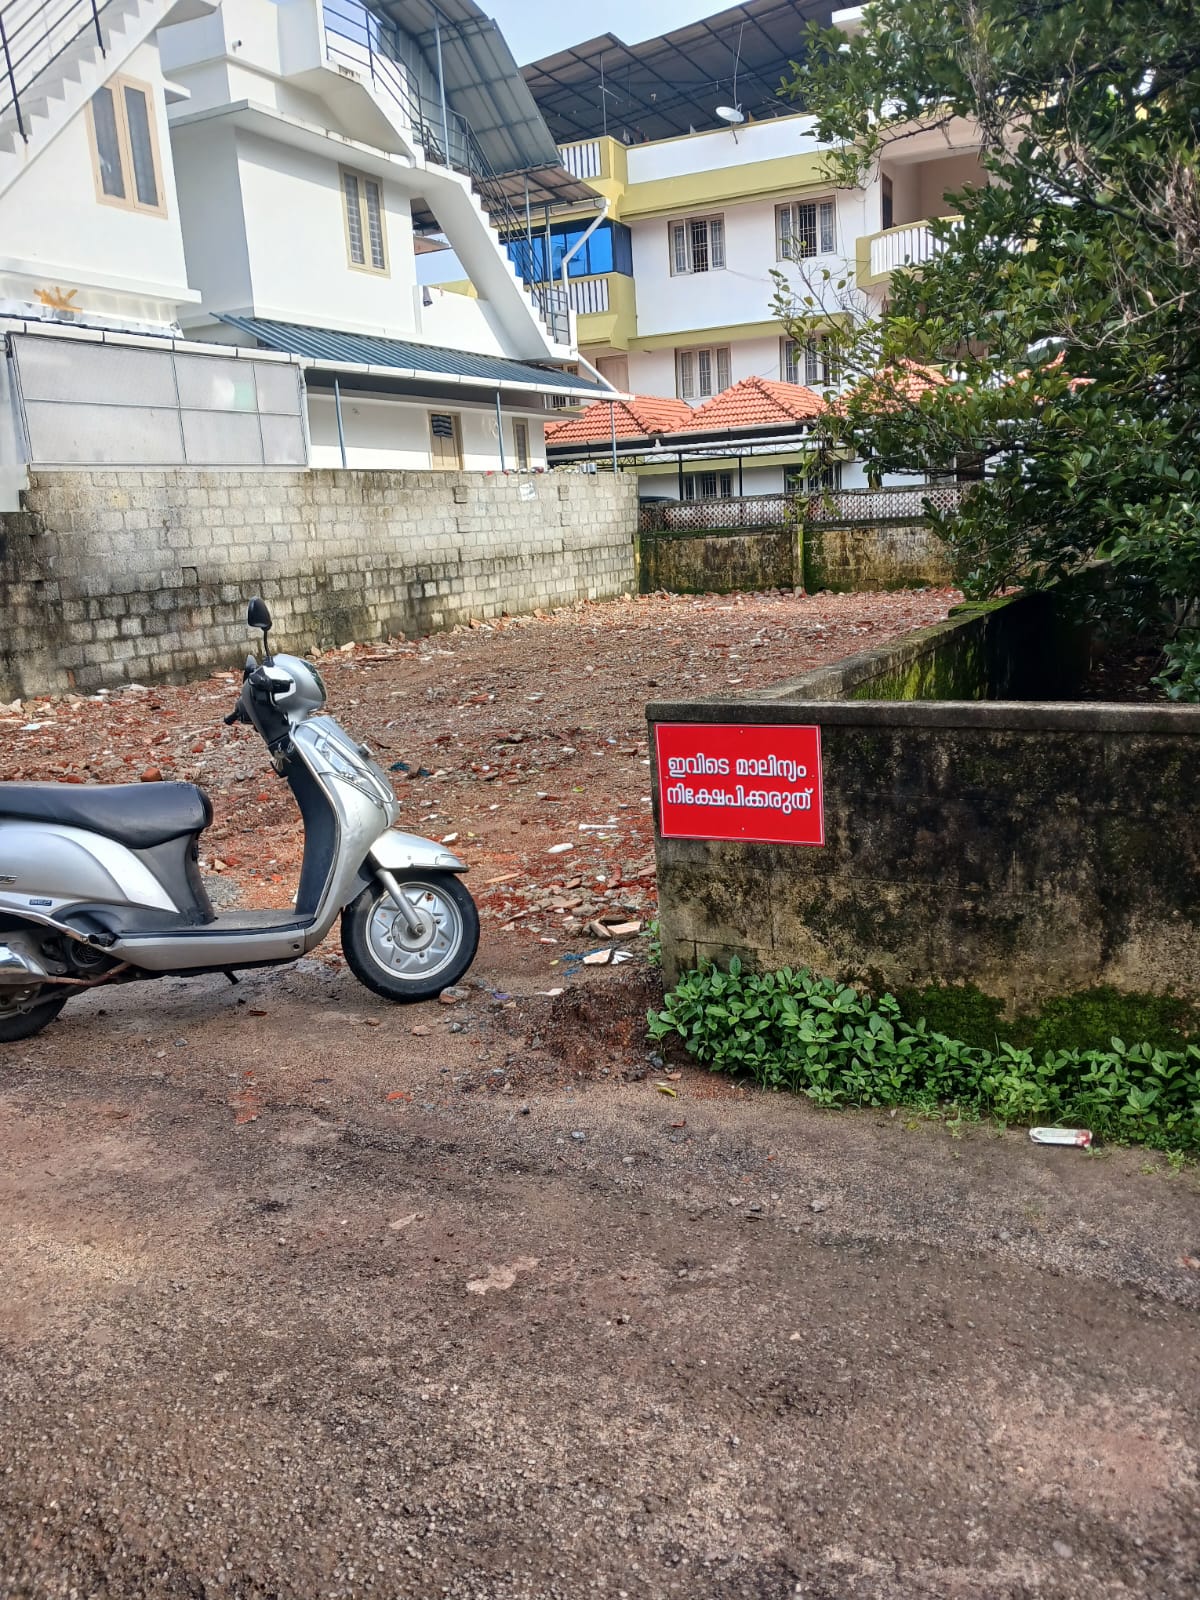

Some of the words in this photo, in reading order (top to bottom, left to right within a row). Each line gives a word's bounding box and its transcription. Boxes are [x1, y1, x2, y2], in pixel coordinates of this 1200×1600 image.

[668, 753, 730, 778] ഇവിടെ
[736, 755, 807, 782] മാലിന്യം
[667, 783, 814, 814] നിക്ഷേപിക്കരുത്
